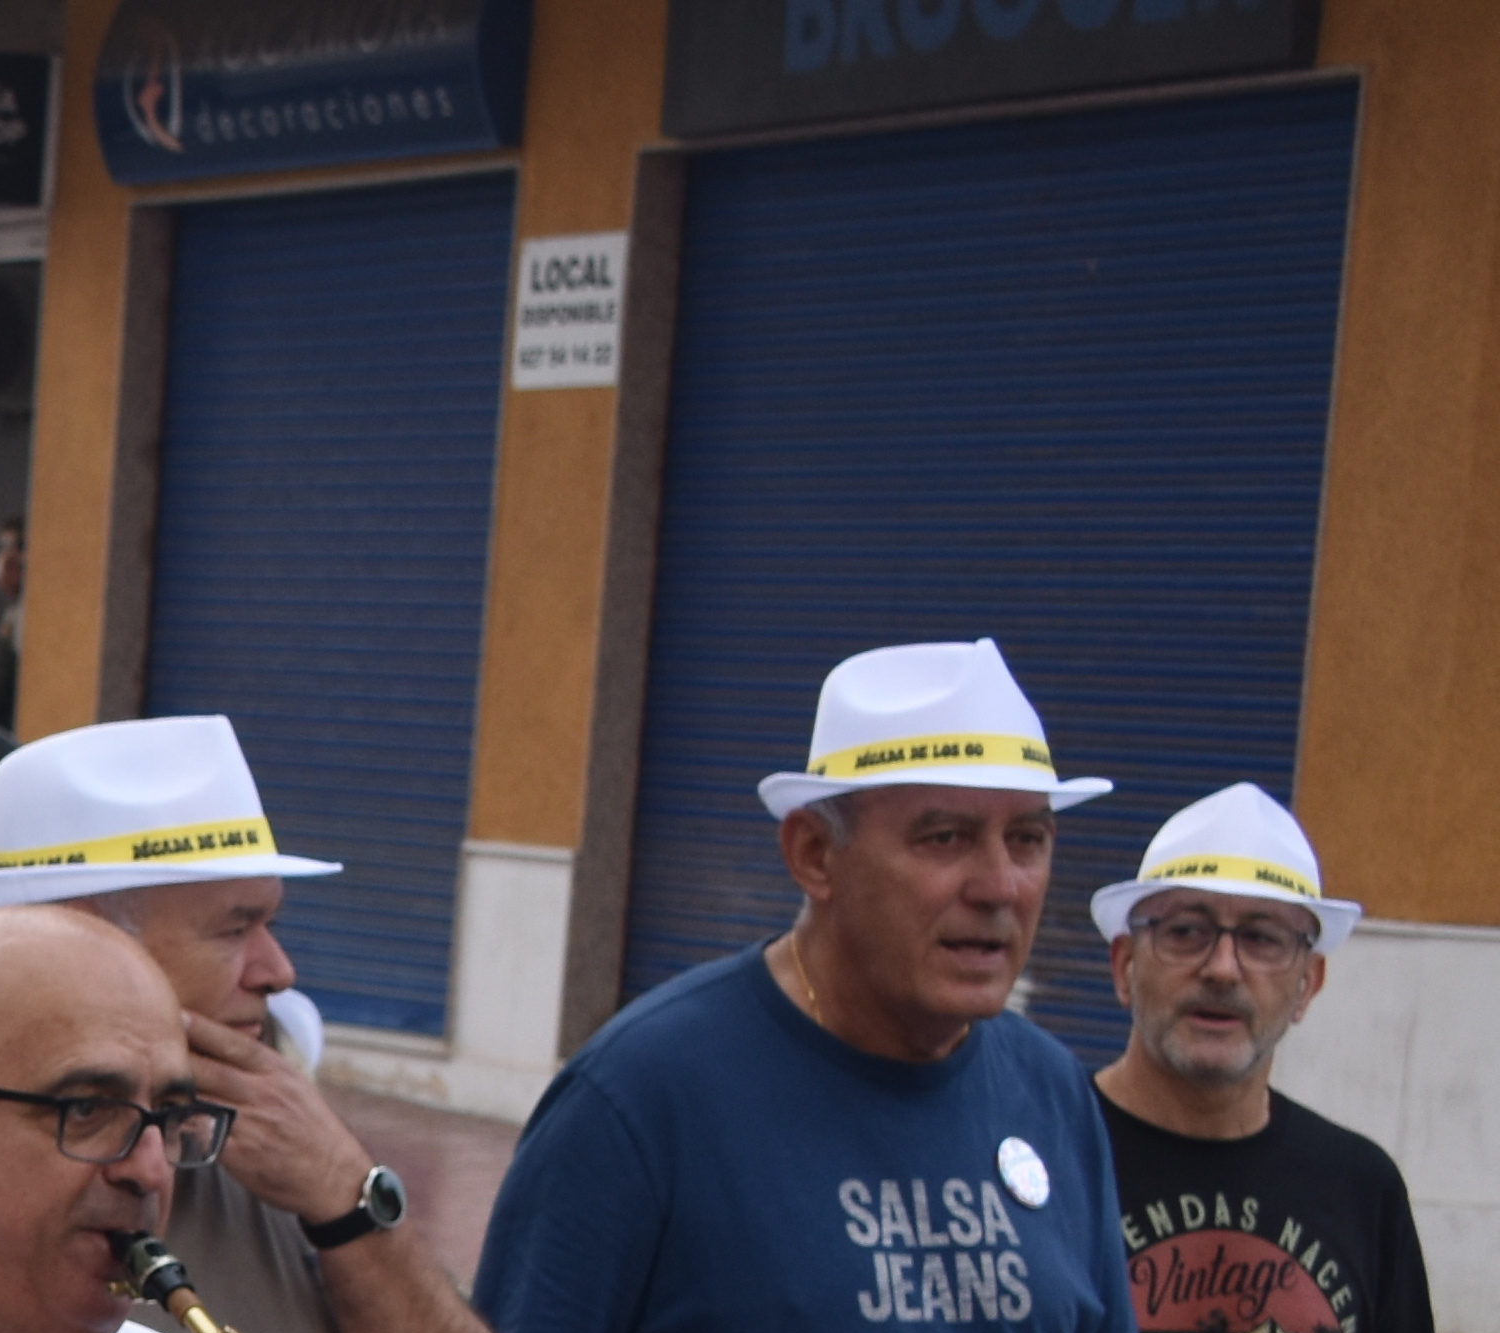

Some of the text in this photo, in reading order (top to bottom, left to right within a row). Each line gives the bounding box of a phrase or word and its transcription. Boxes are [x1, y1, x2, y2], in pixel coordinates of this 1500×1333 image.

[195, 84, 453, 143] decoraciones
[530, 254, 613, 293] LOCAL
[522, 302, 617, 328] DISPONIBLE
[854, 745, 906, 769] DÉCADA
[910, 744, 929, 761] DE
[932, 742, 960, 758] LOS
[131, 832, 194, 861] DÉCADA
[196, 832, 216, 852] DE
[220, 829, 244, 848] LOS
[1255, 867, 1296, 890] DÉCADA
[838, 1178, 1021, 1248] SALSA
[1120, 1192, 1260, 1251] ENDAS
[857, 1250, 1033, 1324] JEANS
[1130, 1243, 1299, 1323] Vintage
